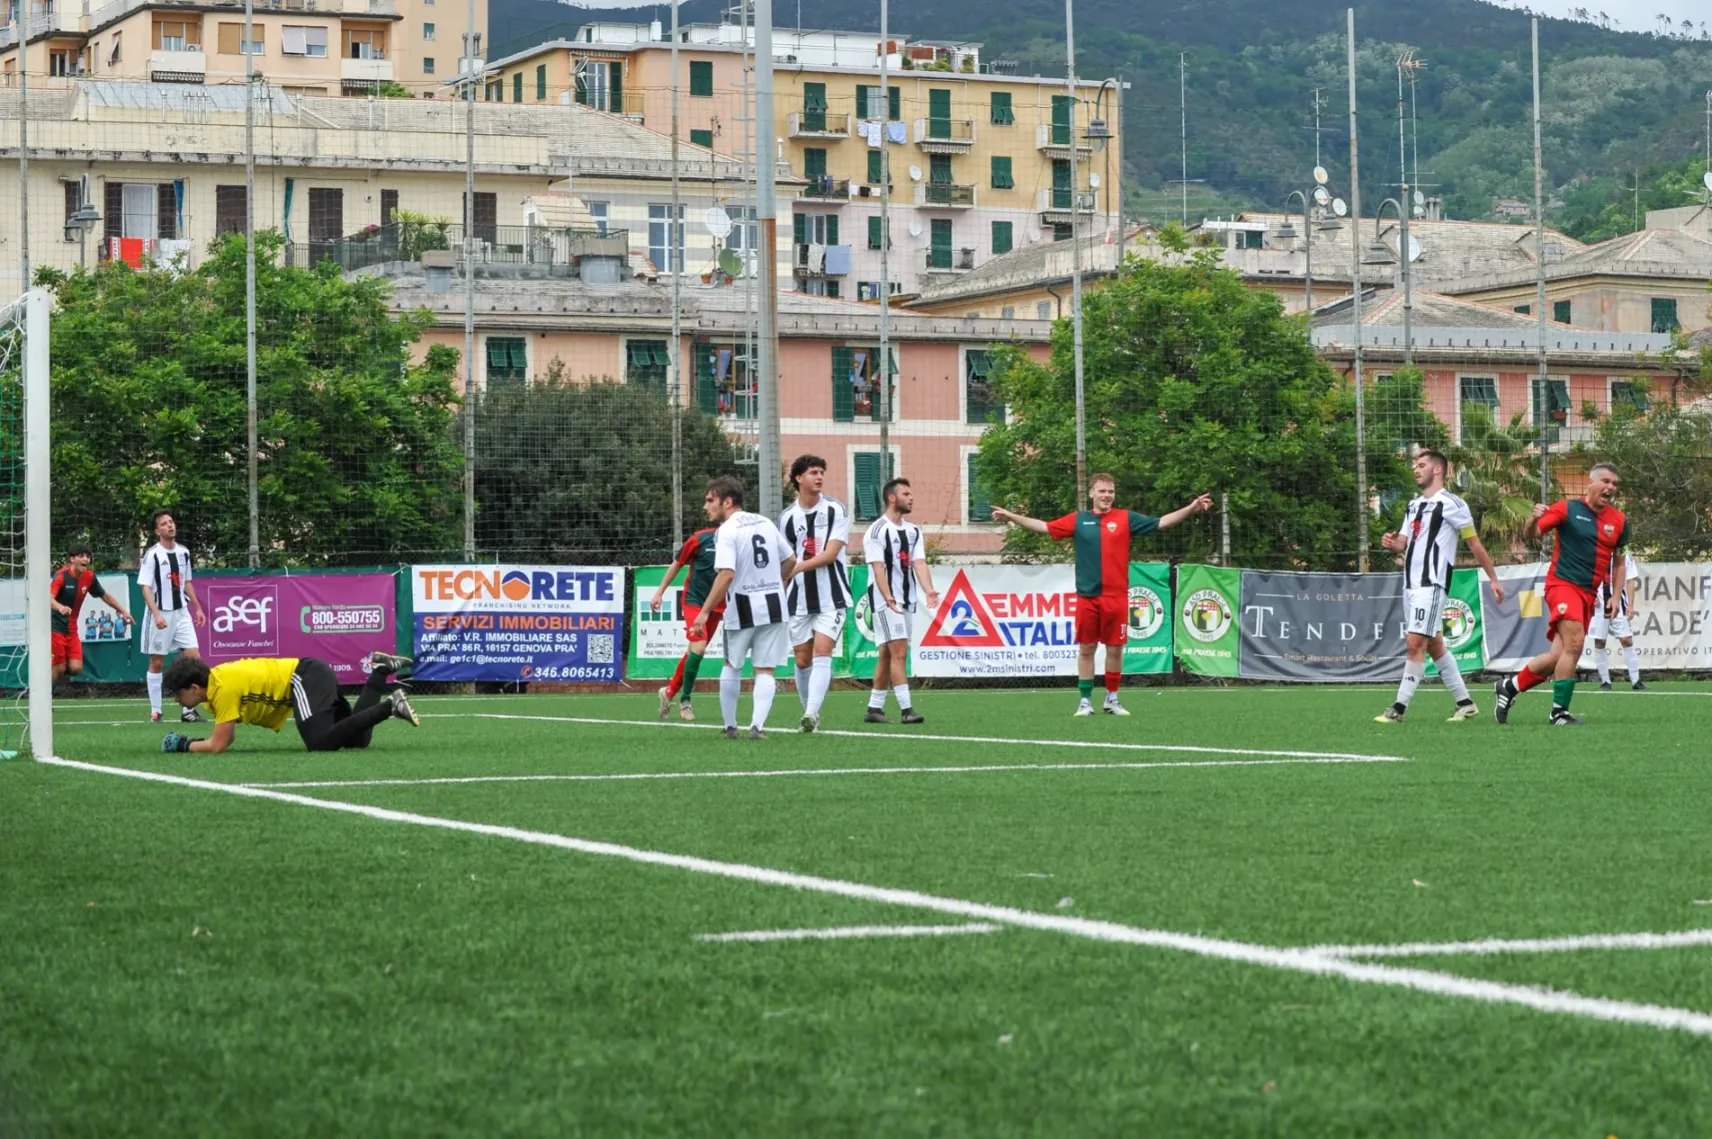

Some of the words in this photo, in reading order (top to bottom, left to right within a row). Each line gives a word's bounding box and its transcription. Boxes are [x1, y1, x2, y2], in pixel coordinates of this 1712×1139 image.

[751, 533, 769, 568] 6
[419, 570, 614, 601] TECNORETE
[1296, 593, 1310, 601] LA
[1316, 593, 1364, 601] GOLETTA
[981, 593, 1077, 617] EMME
[212, 595, 274, 633] asef
[312, 610, 380, 624] 800-550755
[834, 611, 842, 624] 5
[1414, 607, 1425, 621] 10
[423, 616, 494, 630] SERVIZI
[499, 616, 615, 630] IMMOBILIARI
[421, 633, 461, 642] Affiliato:
[464, 633, 483, 642] V.R.
[485, 633, 553, 643] IMMOBILIARE
[555, 633, 577, 643] SAS
[999, 622, 1079, 646] ITALI
[421, 644, 436, 653] VIA
[485, 643, 511, 652] 16157
[512, 644, 552, 653] GENOVA
[554, 643, 577, 653] PRA'
[919, 651, 972, 660] GESTIONE
[974, 651, 1016, 660] SINISTRI
[1024, 651, 1041, 660] tel.
[1043, 651, 1080, 660] 800323
[535, 667, 614, 679] 346.8065413
[959, 664, 1056, 674] www.2msinistri.com
